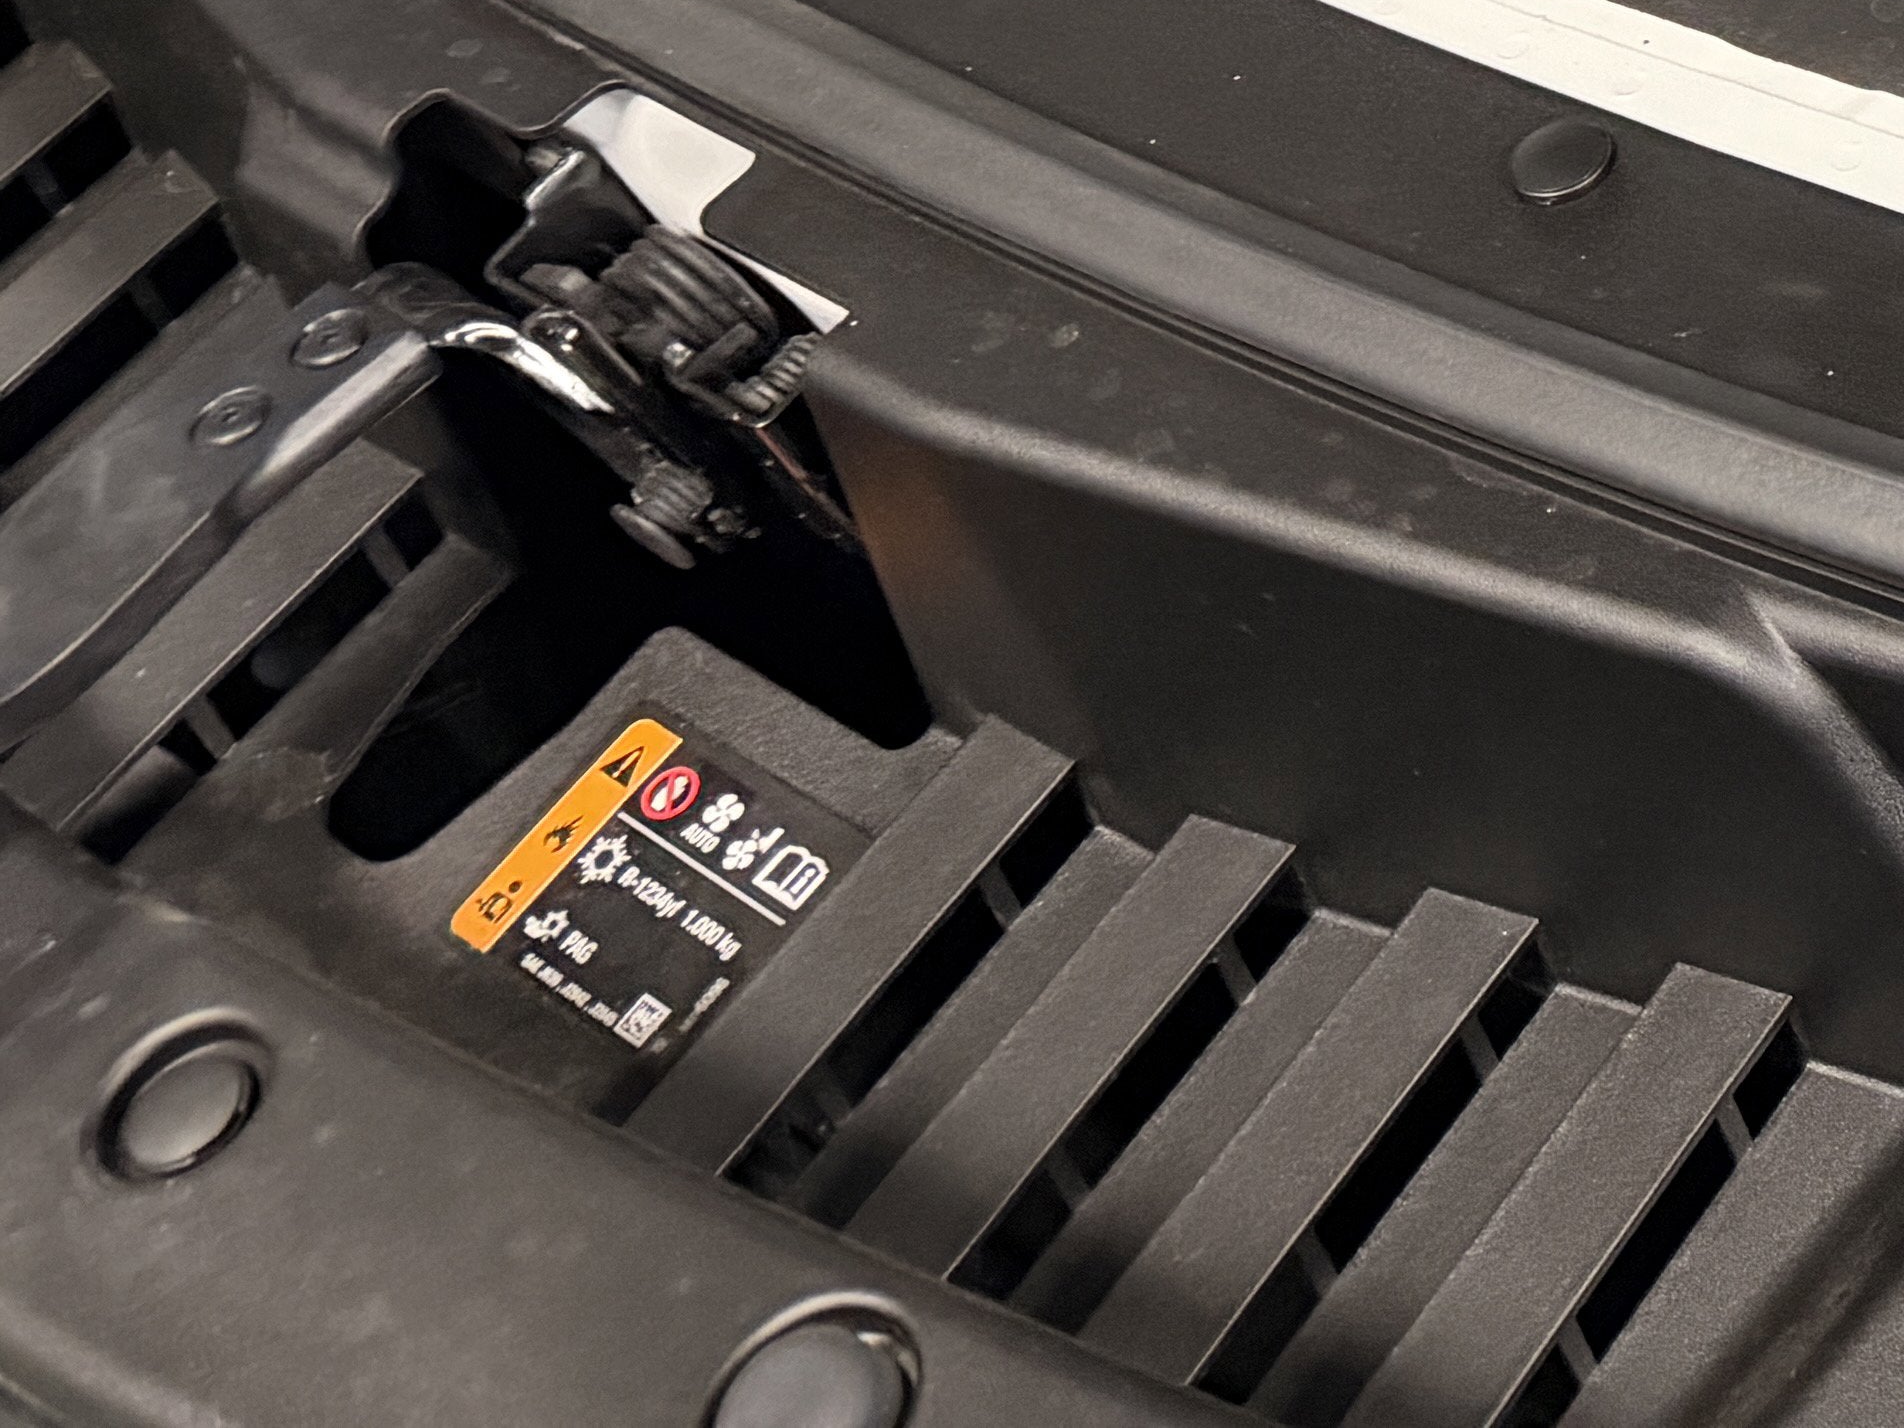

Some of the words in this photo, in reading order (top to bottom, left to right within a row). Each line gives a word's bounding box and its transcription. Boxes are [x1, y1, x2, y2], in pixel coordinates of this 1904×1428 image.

[680, 823, 721, 854] AUTO
[558, 930, 599, 965] PAG
[714, 932, 743, 962] kg
